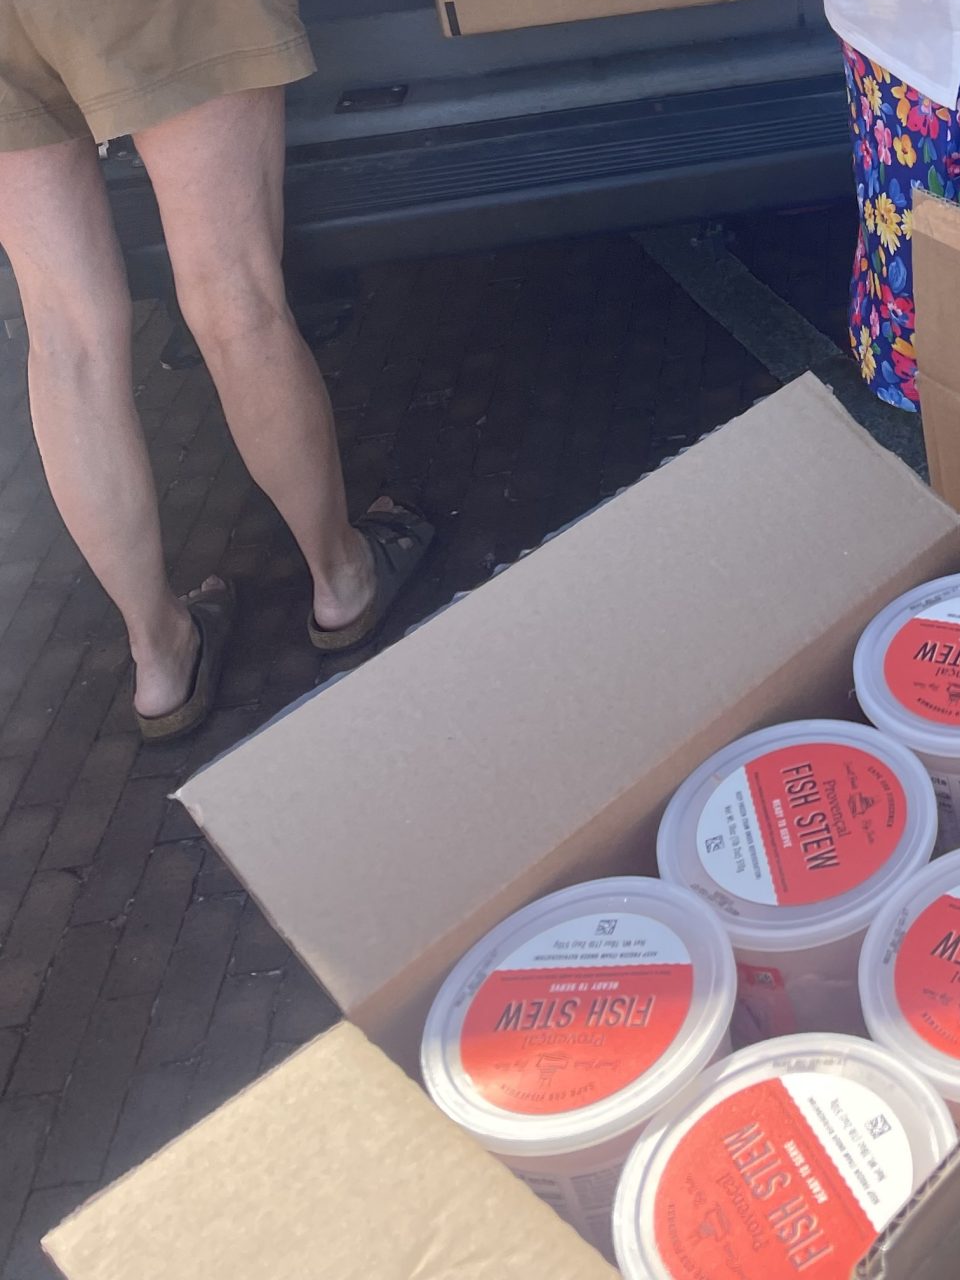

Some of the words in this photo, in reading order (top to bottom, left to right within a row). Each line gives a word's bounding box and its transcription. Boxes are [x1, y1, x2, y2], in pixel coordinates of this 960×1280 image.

[781, 763, 820, 808] FISH
[772, 799, 784, 816] READY
[778, 818, 786, 826] TO
[823, 779, 851, 838] Provençal
[780, 828, 792, 848] SERVE
[796, 812, 840, 871] STEW
[549, 982, 575, 993] SERVE
[578, 982, 589, 990] TO
[590, 981, 619, 990] READY
[495, 997, 578, 1031] STEW
[586, 995, 654, 1028] FISH
[723, 1122, 791, 1201] STEW
[766, 1195, 835, 1272] FISH
